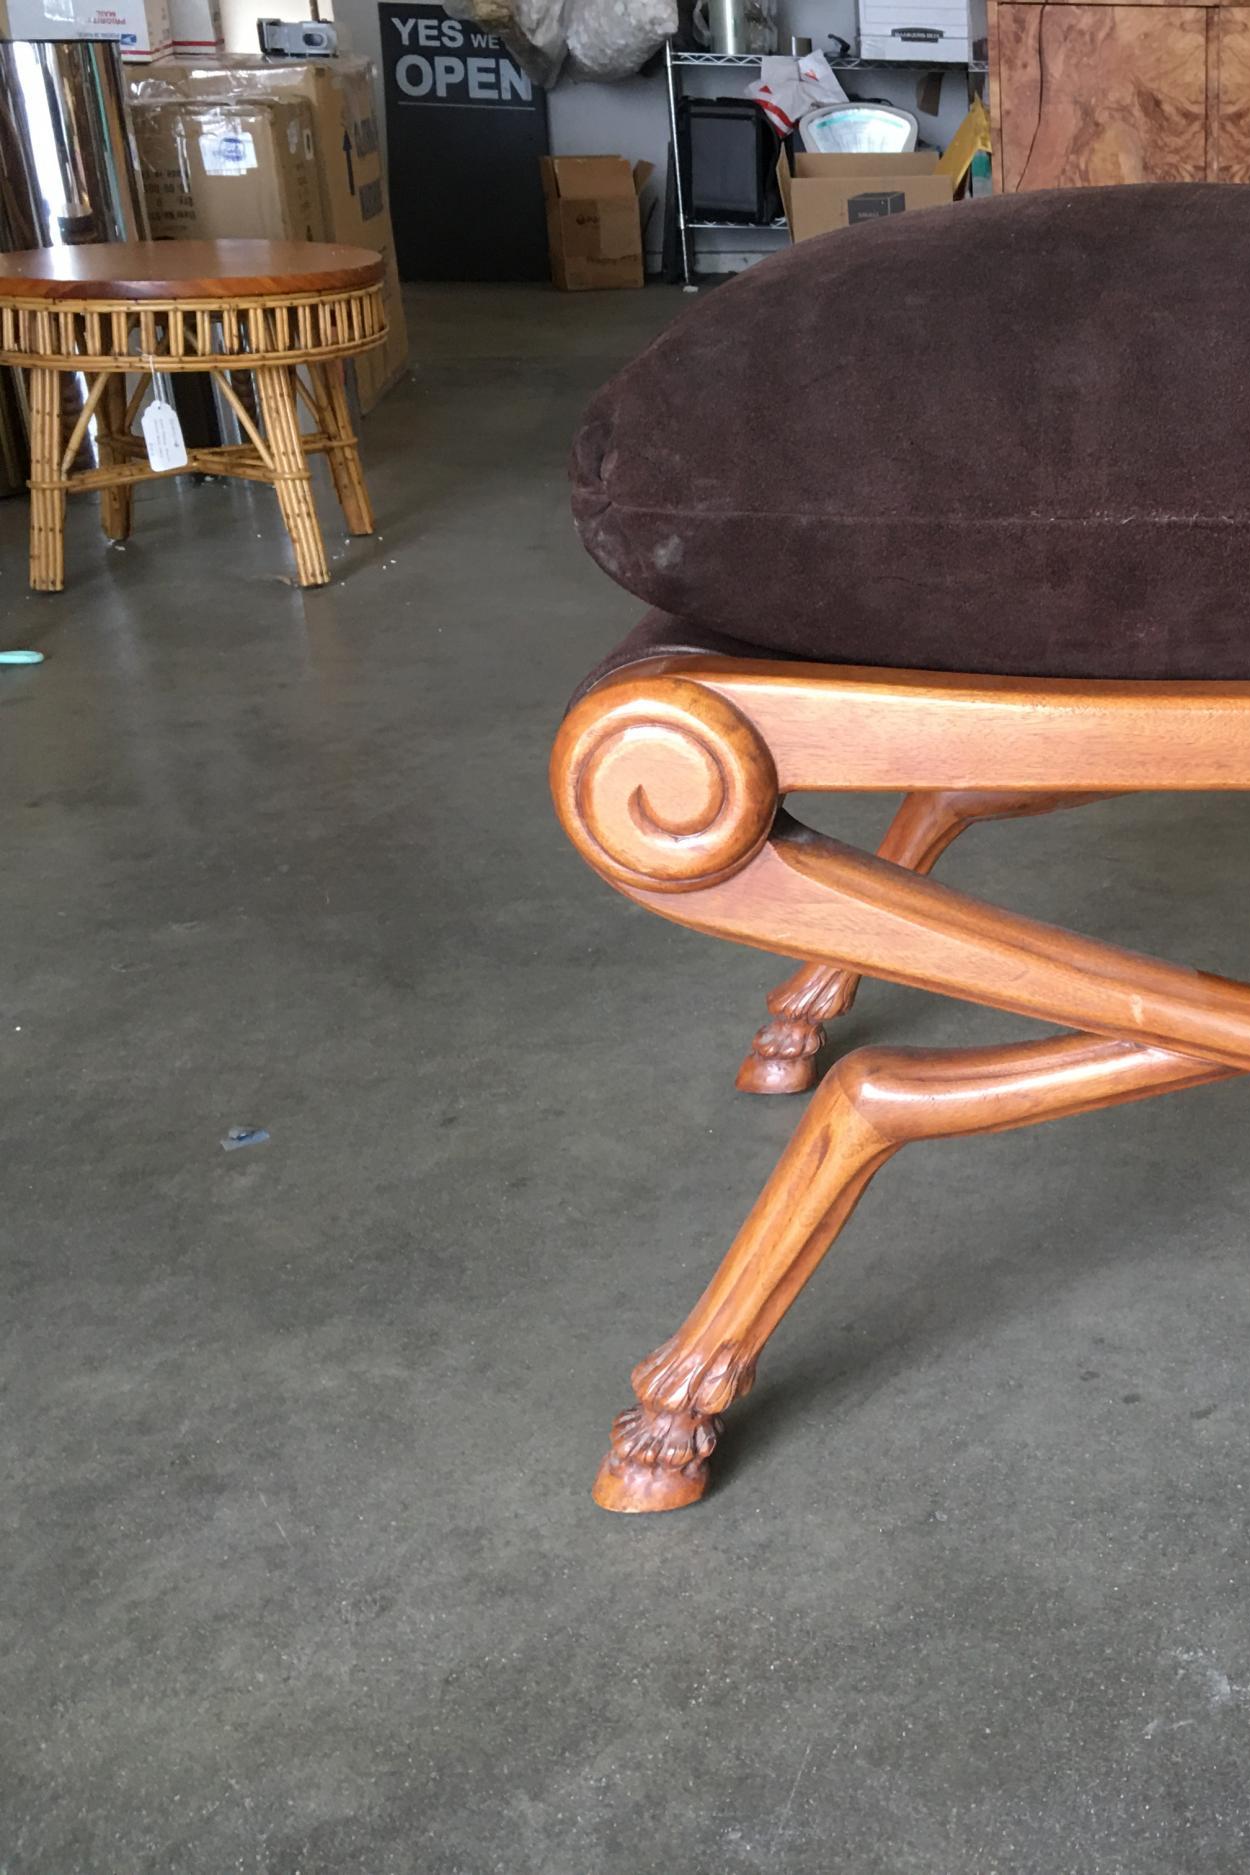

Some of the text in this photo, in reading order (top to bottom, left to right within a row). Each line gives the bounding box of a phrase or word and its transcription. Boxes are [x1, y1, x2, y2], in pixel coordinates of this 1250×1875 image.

[391, 17, 500, 48] YES WE
[395, 54, 532, 101] OPEN
